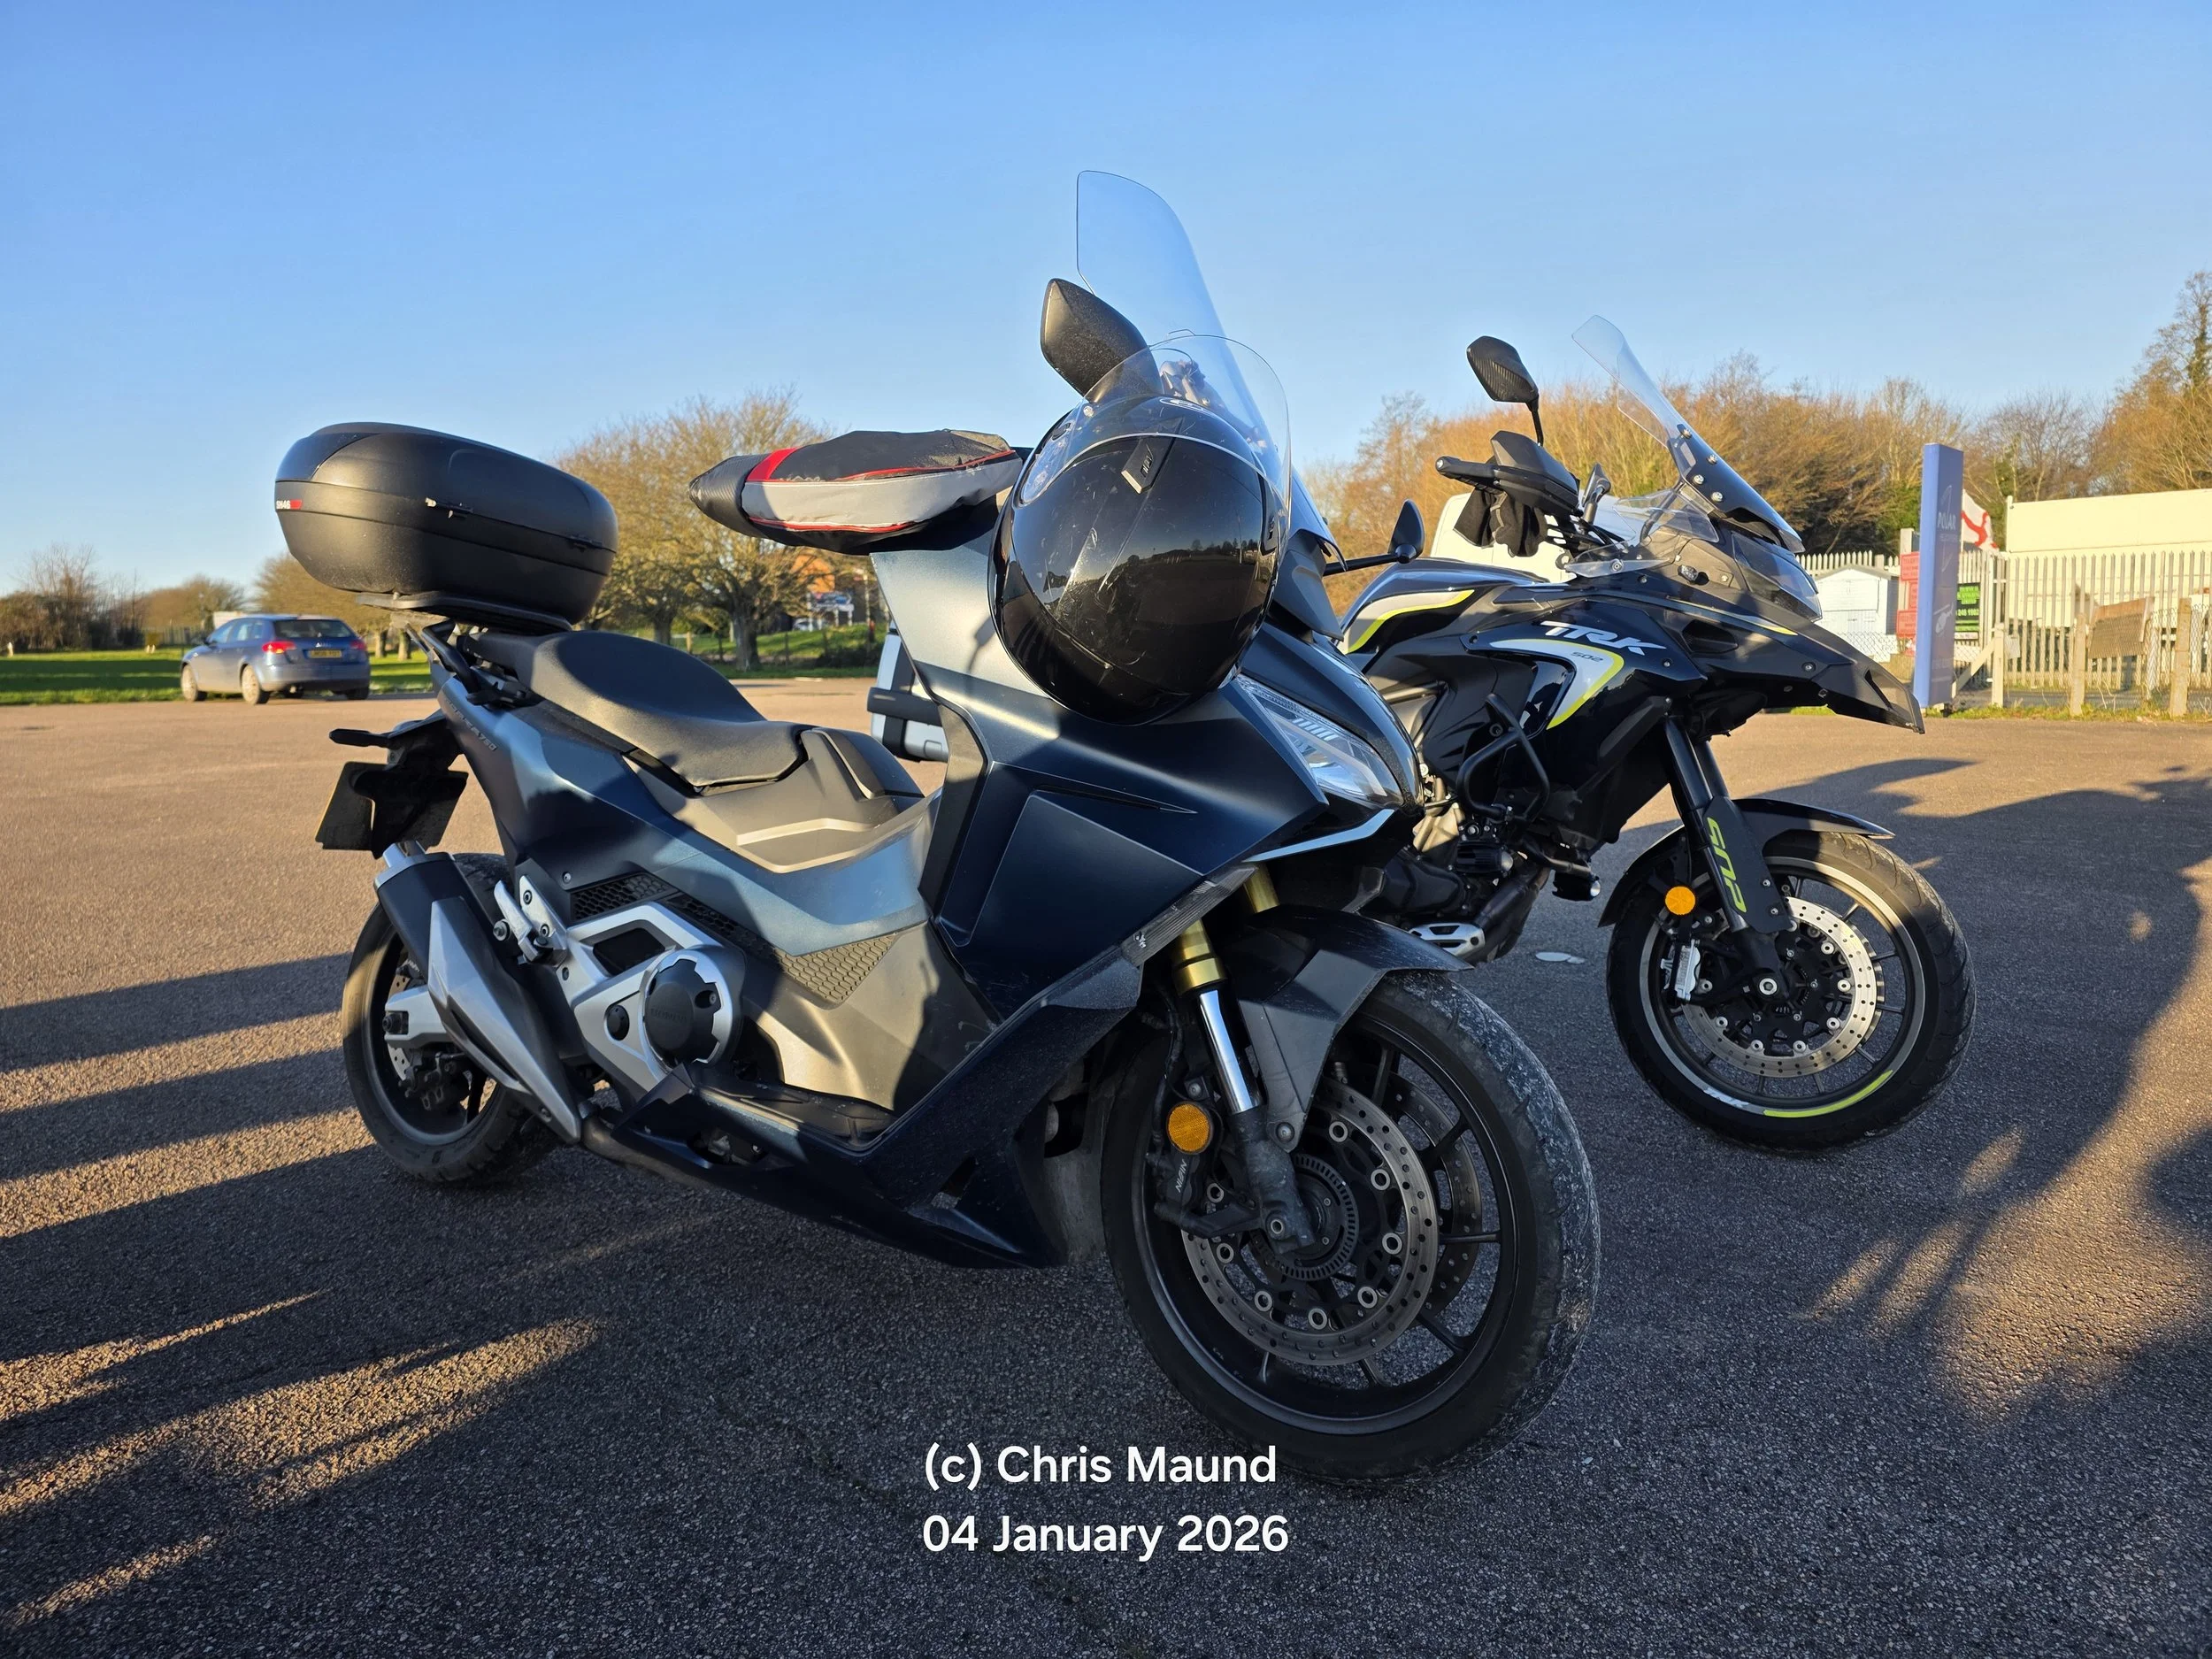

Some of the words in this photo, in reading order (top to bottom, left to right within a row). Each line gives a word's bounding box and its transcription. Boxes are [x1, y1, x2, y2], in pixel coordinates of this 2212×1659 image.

[275, 500, 290, 510] SH46
[1937, 511, 1956, 530] POLAR
[1540, 620, 1667, 656] TRK
[1571, 651, 1603, 663] 502
